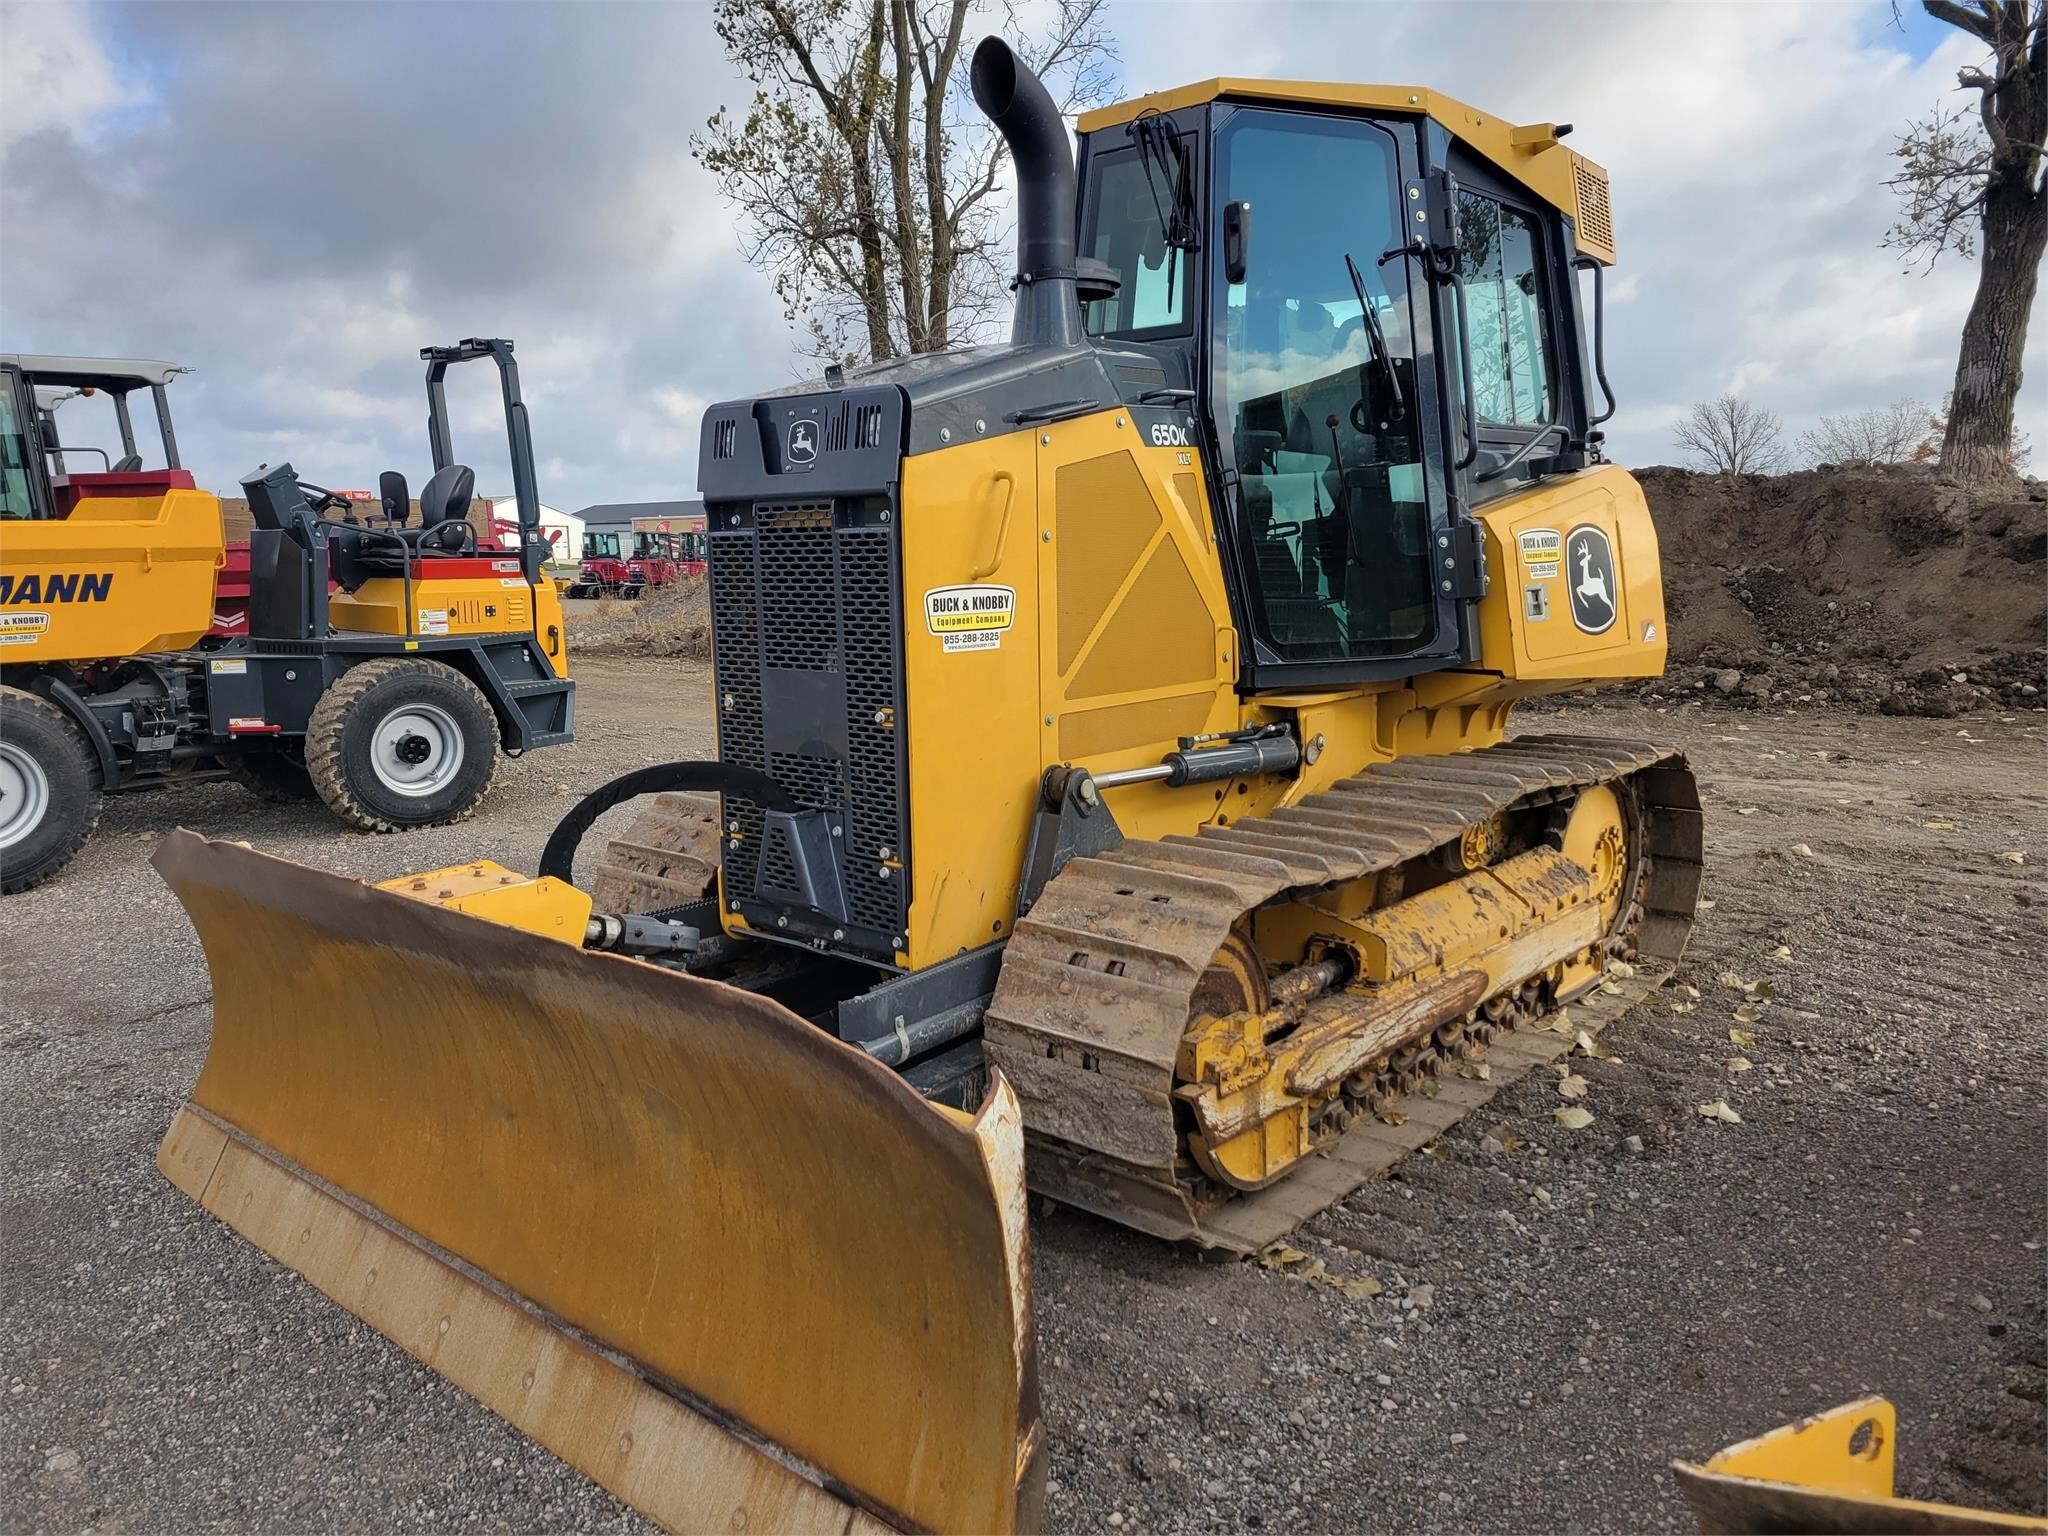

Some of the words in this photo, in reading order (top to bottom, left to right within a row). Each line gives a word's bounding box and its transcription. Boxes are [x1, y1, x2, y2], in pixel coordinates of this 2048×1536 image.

[1151, 424, 1189, 446] 650K
[1177, 452, 1191, 465] XLT
[932, 597, 959, 612] BUCK
[962, 599, 969, 611] &
[972, 595, 1009, 610] KNOBBY
[12, 616, 45, 625] KNOBBY
[937, 616, 973, 626] Equipment
[975, 615, 1005, 624] Company
[944, 632, 999, 644] 855-288-2825
